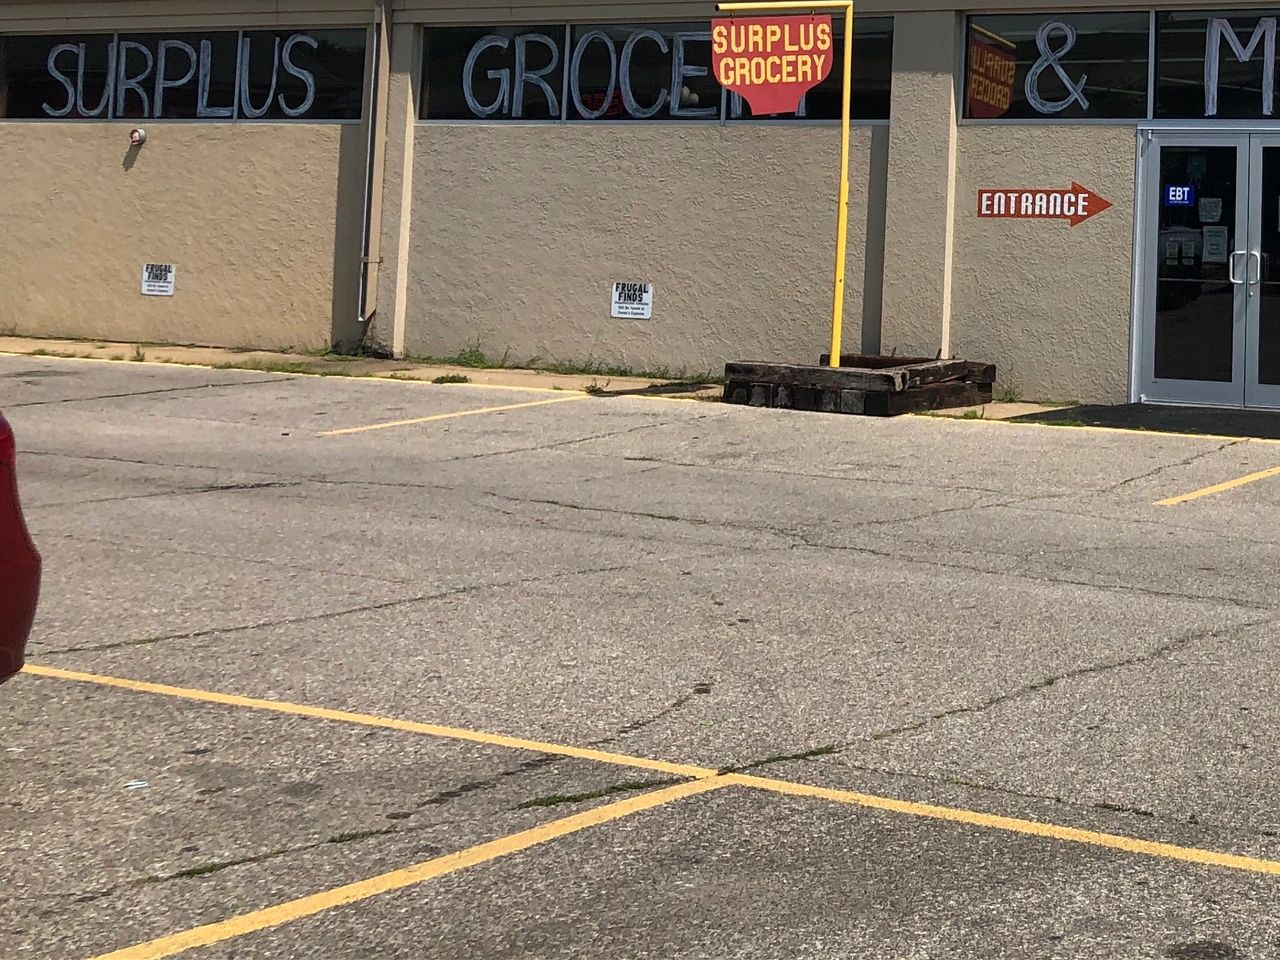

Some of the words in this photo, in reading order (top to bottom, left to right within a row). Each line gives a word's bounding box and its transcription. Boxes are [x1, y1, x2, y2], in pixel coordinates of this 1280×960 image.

[713, 23, 831, 54] SURPLUS
[42, 33, 318, 117] SURPLUS
[462, 30, 806, 119] GROCE
[1025, 20, 1090, 115] &
[720, 54, 825, 86] GROCERY
[981, 192, 1089, 216] ENTRANCE
[1169, 186, 1190, 201] EBT
[615, 282, 649, 293] FRUGAL
[618, 291, 643, 302] FINDS
